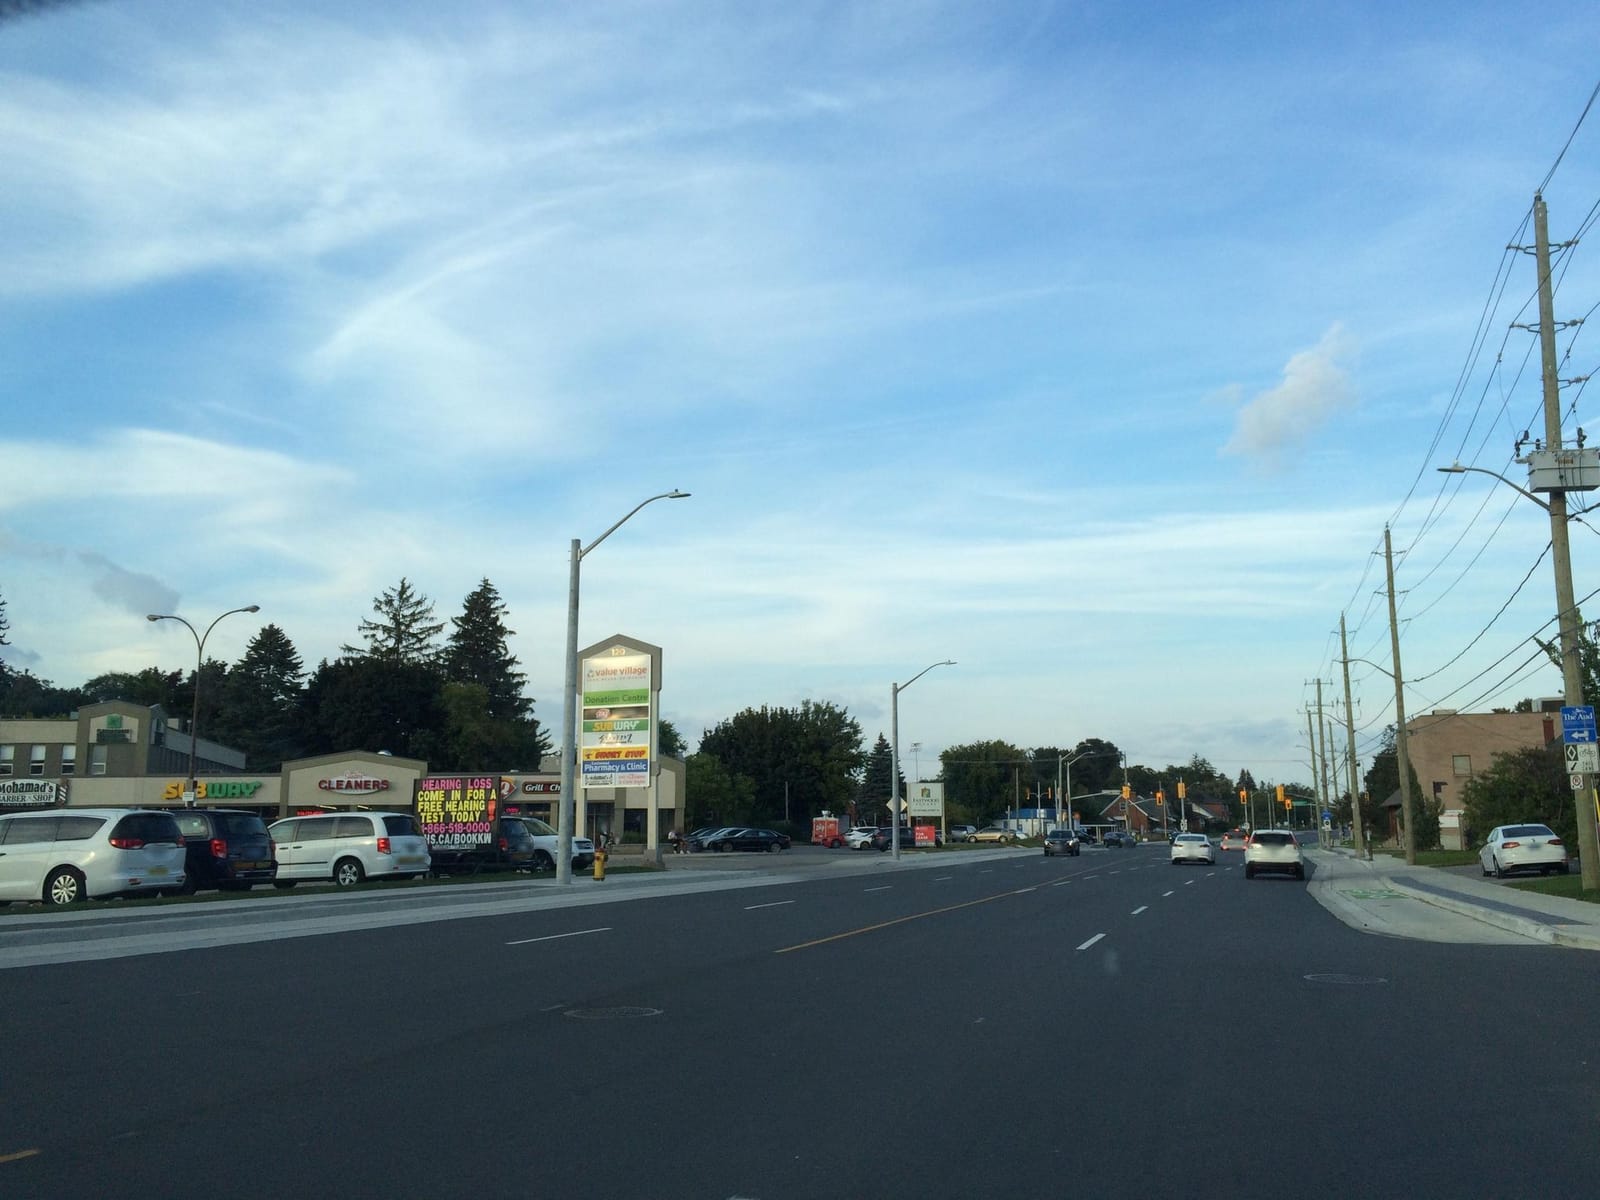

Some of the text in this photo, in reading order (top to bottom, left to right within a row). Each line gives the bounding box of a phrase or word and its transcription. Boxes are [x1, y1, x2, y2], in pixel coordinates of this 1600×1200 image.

[595, 666, 648, 677] value village
[585, 696, 619, 704] Donation
[1564, 712, 1593, 721] The Aud
[592, 721, 640, 732] SUBWAY
[584, 764, 620, 772] Pharmacy
[626, 761, 646, 770] Clinic
[318, 779, 390, 791] CLEANERS
[422, 778, 492, 790] HEARING LOSS
[525, 783, 543, 791] Grill
[161, 781, 262, 800] SBWAY
[417, 788, 497, 801] COME IN FOR A
[33, 794, 54, 802] SHOP
[417, 801, 443, 812] FREE
[445, 800, 485, 811] HEARING
[420, 811, 480, 823] TEST TODAY
